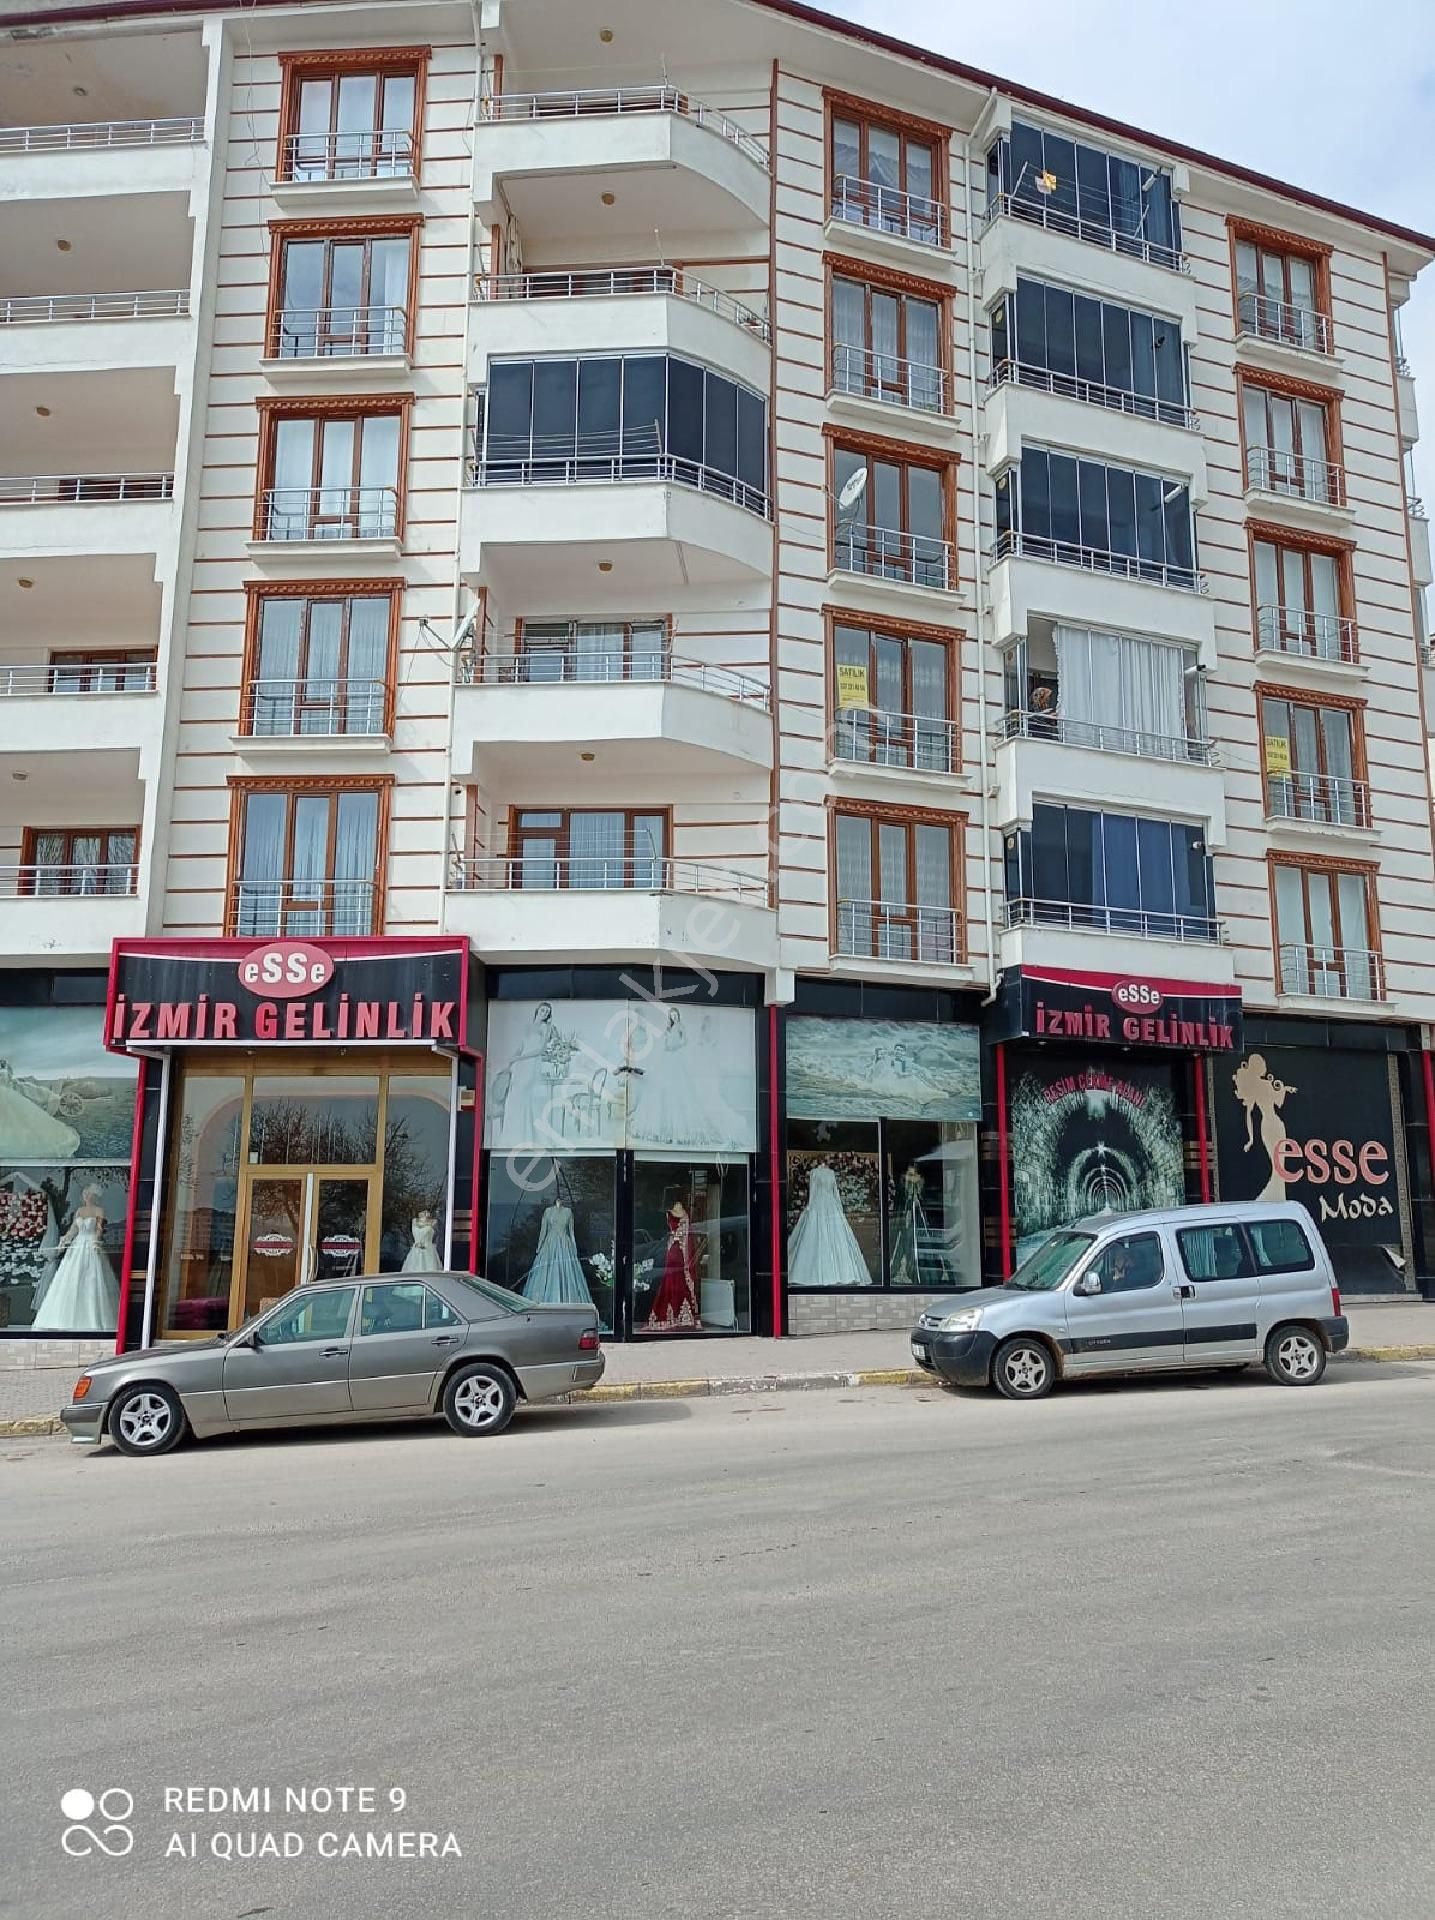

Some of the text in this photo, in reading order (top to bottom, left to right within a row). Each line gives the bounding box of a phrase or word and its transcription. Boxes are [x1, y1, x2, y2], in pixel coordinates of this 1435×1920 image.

[244, 952, 325, 984] eSSe
[113, 992, 456, 1039] İZMİR GELİNLİK
[1036, 1001, 1233, 1049] İZMİR GELİNLİK
[1272, 1138, 1389, 1185] esse
